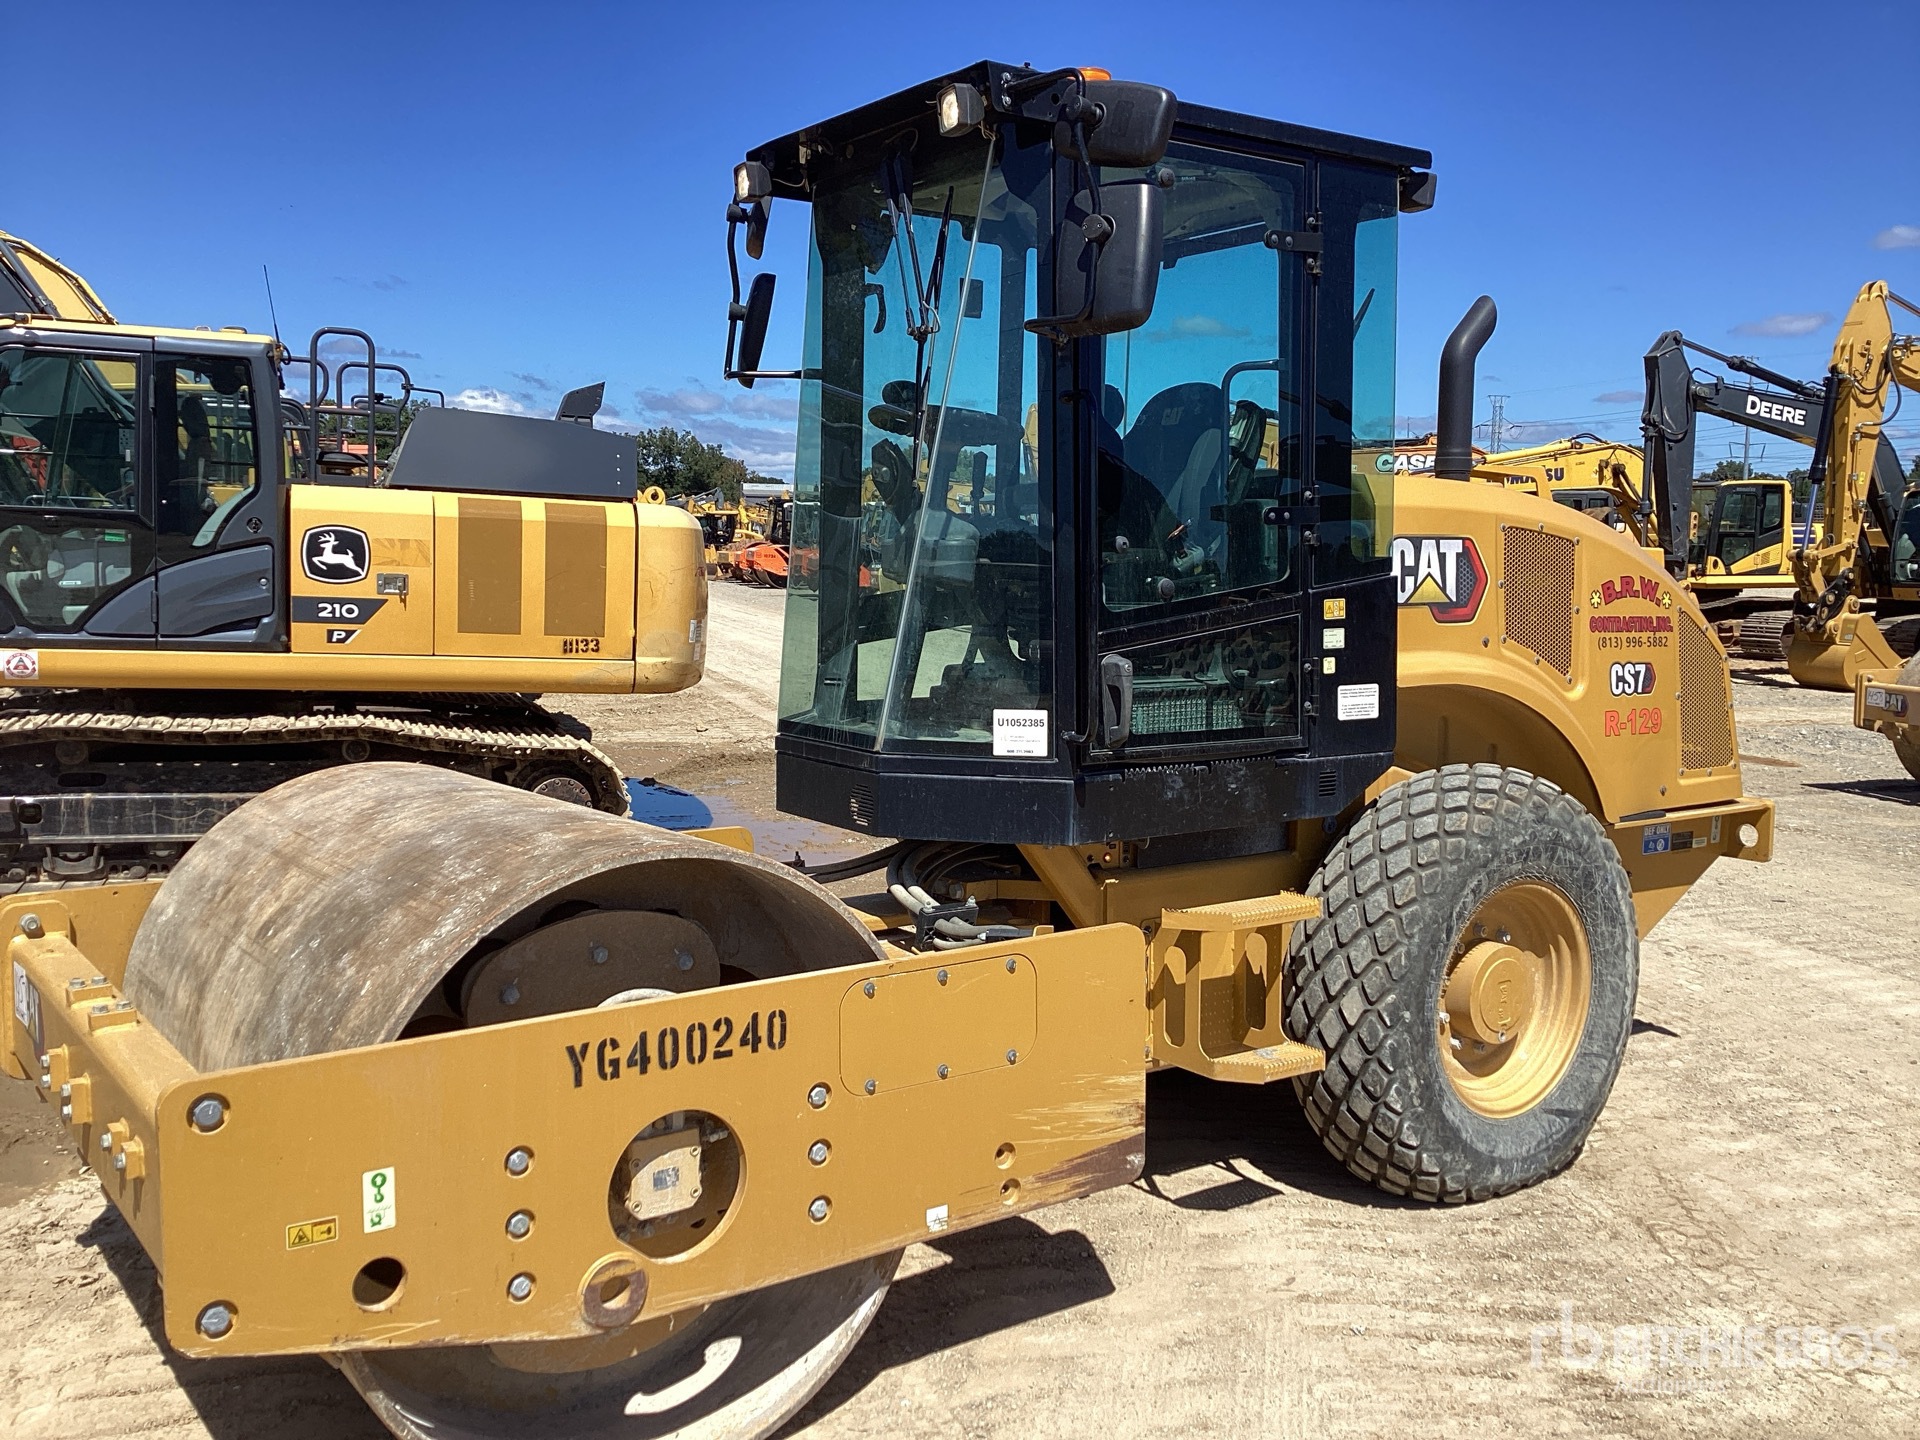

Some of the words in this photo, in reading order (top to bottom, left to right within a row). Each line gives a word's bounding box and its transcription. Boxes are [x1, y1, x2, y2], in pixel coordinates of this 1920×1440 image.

[1746, 394, 1807, 426] DEERE
[1391, 538, 1463, 604] CAT
[1601, 575, 1662, 608] B.R.W.
[318, 603, 359, 618] 210
[331, 630, 346, 642] P
[1598, 636, 1623, 651] (813)
[1625, 635, 1669, 648] 996-5882
[1610, 663, 1647, 695] CS7
[997, 718, 1045, 728] U1052385
[1604, 707, 1663, 738] R-129
[1644, 826, 1656, 836] DEF
[1656, 824, 1670, 835] ONLY
[565, 1009, 788, 1089] YG400240
